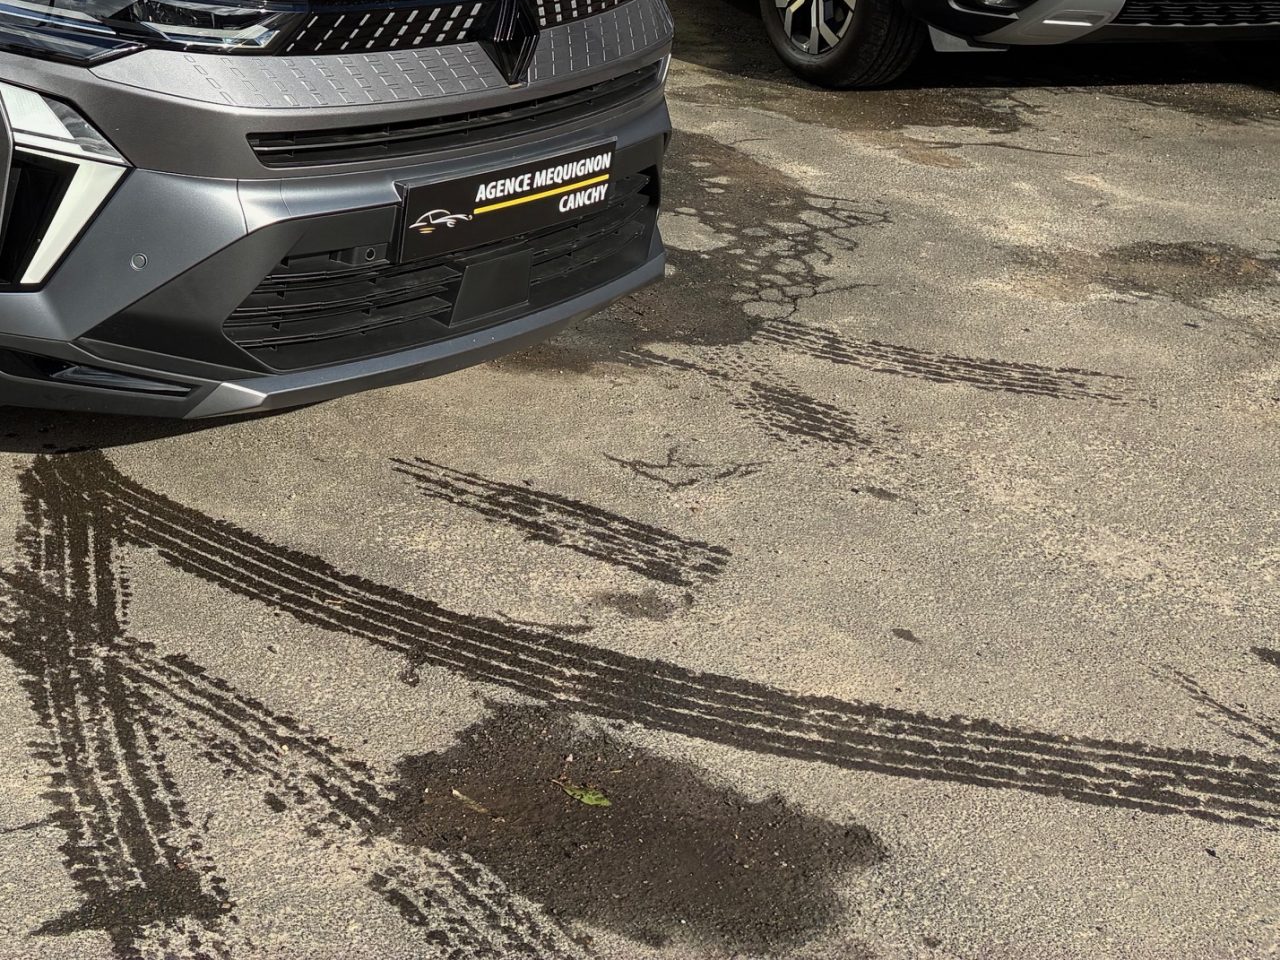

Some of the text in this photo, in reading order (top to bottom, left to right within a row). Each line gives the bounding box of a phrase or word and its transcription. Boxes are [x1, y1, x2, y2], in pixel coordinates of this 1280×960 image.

[475, 152, 612, 202] AGENCE MEQUIGNON
[558, 184, 609, 213] CANCHY
